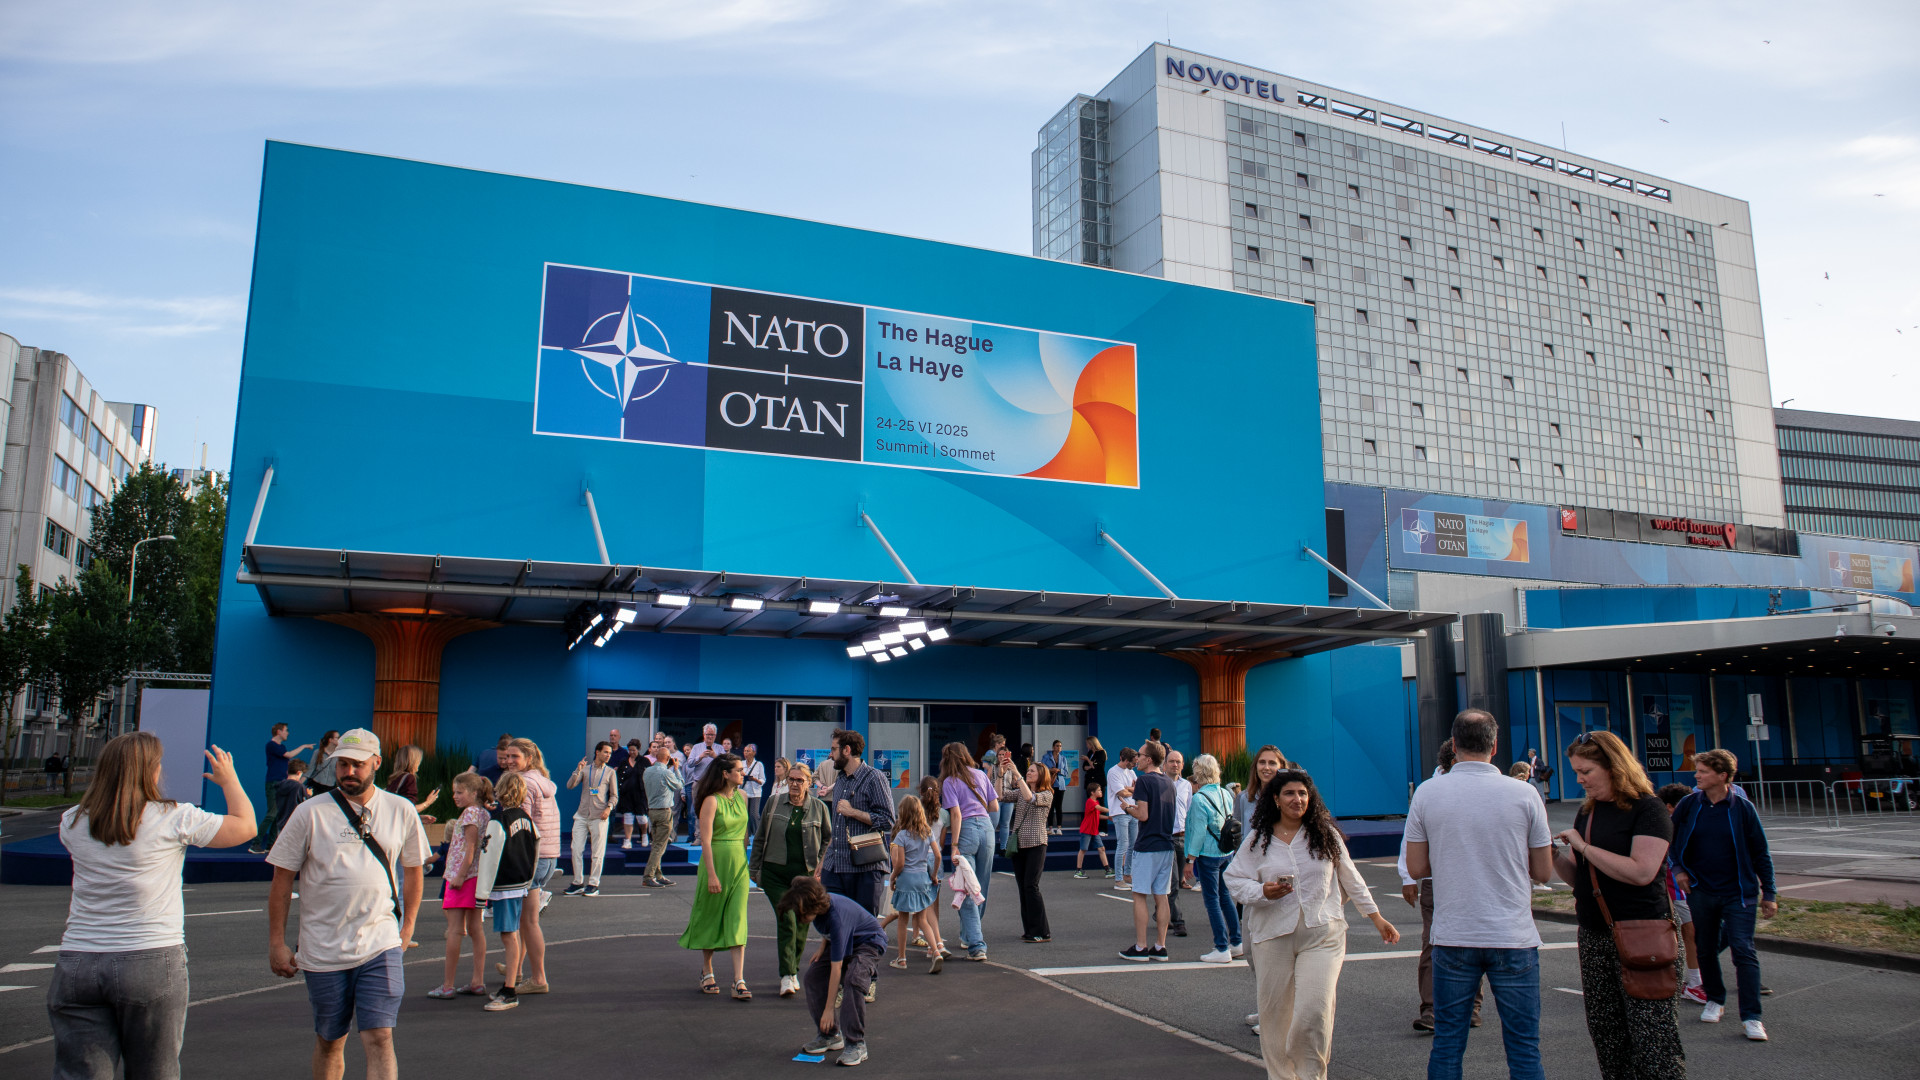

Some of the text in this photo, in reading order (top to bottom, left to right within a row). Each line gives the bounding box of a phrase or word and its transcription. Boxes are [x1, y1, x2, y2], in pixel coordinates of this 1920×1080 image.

[1166, 57, 1284, 102] NOVOTEL
[722, 311, 849, 358] NATO
[878, 321, 994, 354] The Hague
[877, 352, 964, 382] La Haye
[720, 392, 849, 438] OTAN
[876, 416, 968, 437] 24-25 VI 2025
[876, 438, 928, 455] Summit
[940, 445, 996, 462] Sommet
[1438, 518, 1464, 530] NATO
[1652, 518, 1722, 535] world forum
[1438, 540, 1465, 551] OTAN
[1852, 558, 1870, 568] NATO
[1853, 576, 1871, 584] OTAN
[1648, 738, 1669, 747] NATO
[1648, 758, 1670, 766] OTAN
[510, 818, 522, 837] NEW
